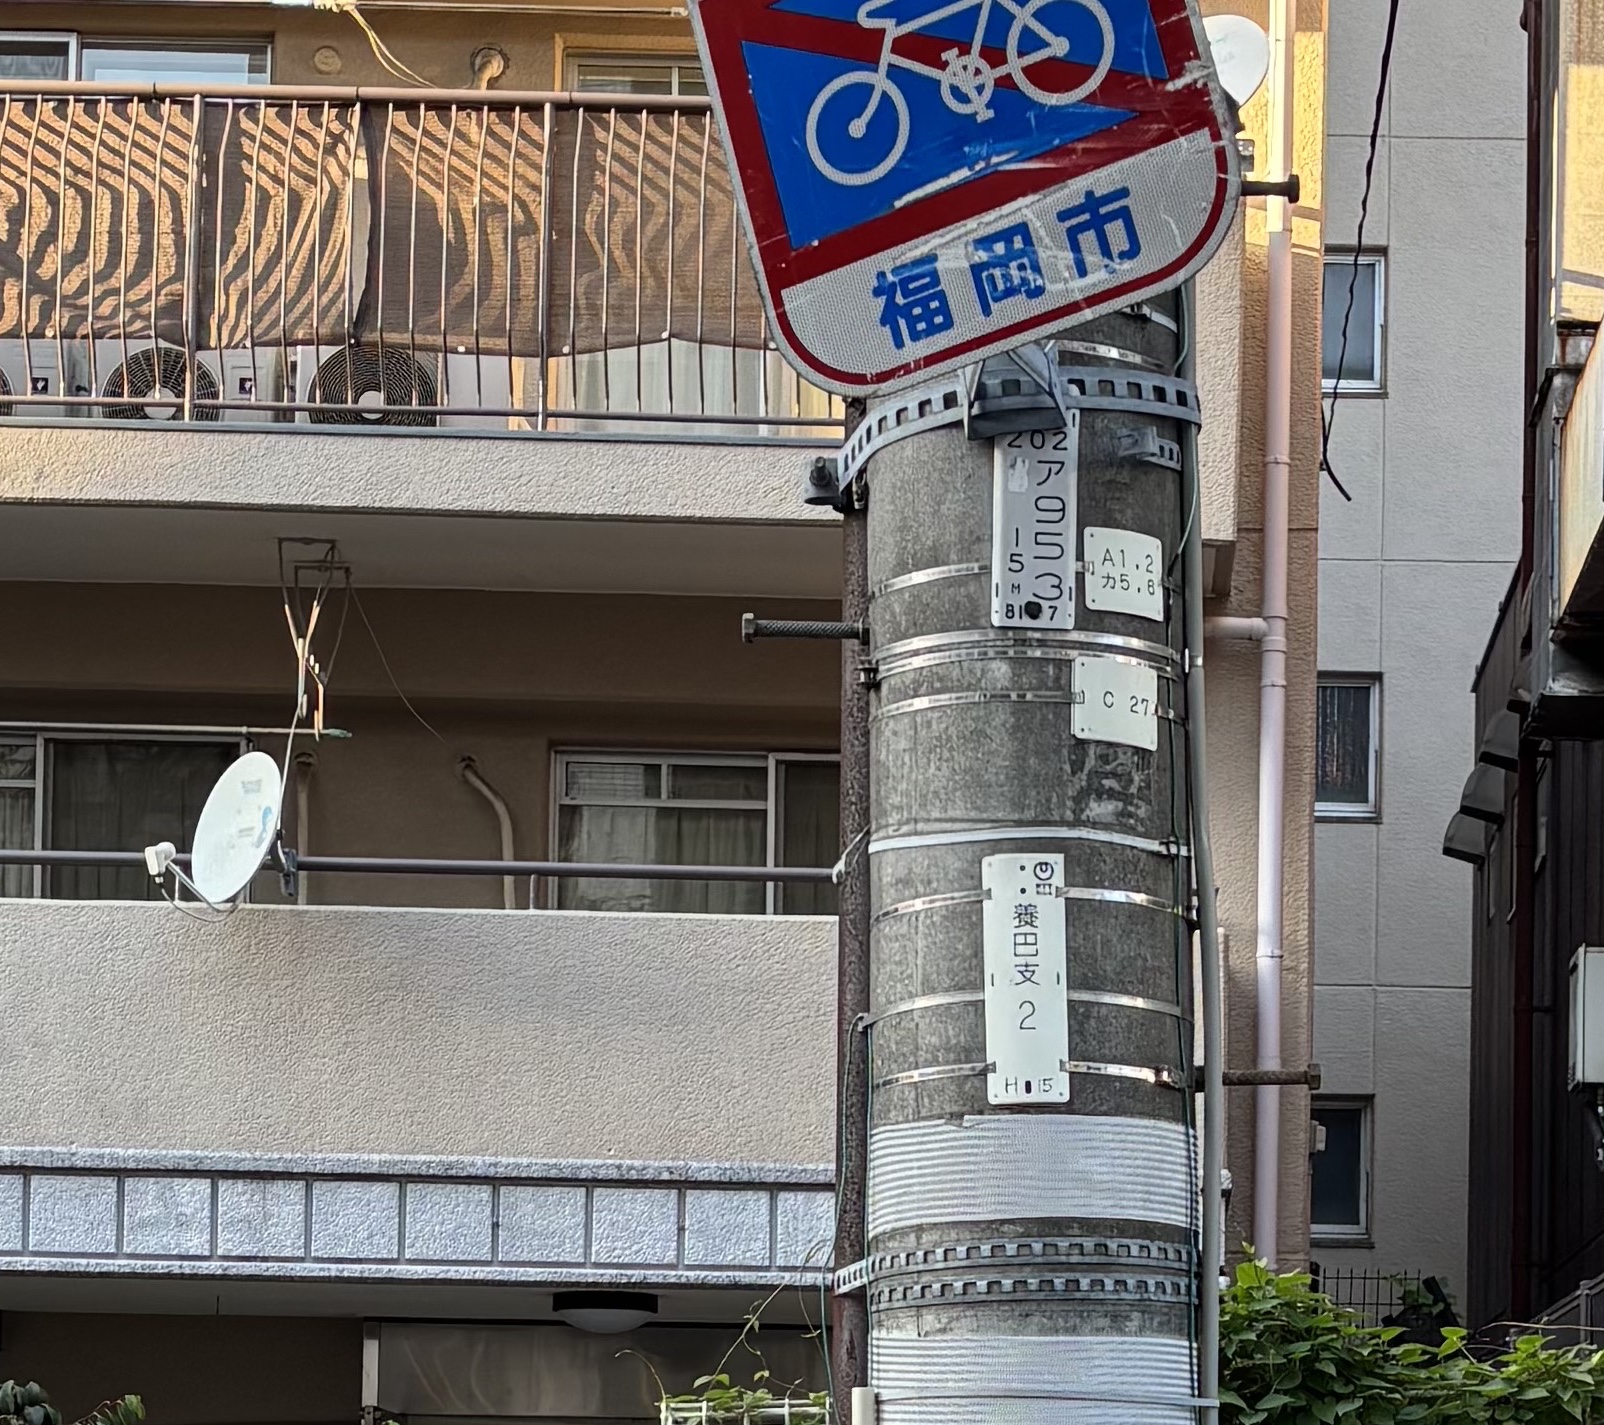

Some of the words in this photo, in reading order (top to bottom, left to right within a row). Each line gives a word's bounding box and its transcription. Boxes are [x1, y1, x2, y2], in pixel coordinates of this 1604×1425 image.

[871, 186, 1142, 350] 福岡市
[1102, 690, 1115, 709] C
[1129, 695, 1150, 716] 27
[1018, 1000, 1037, 1031] 2
